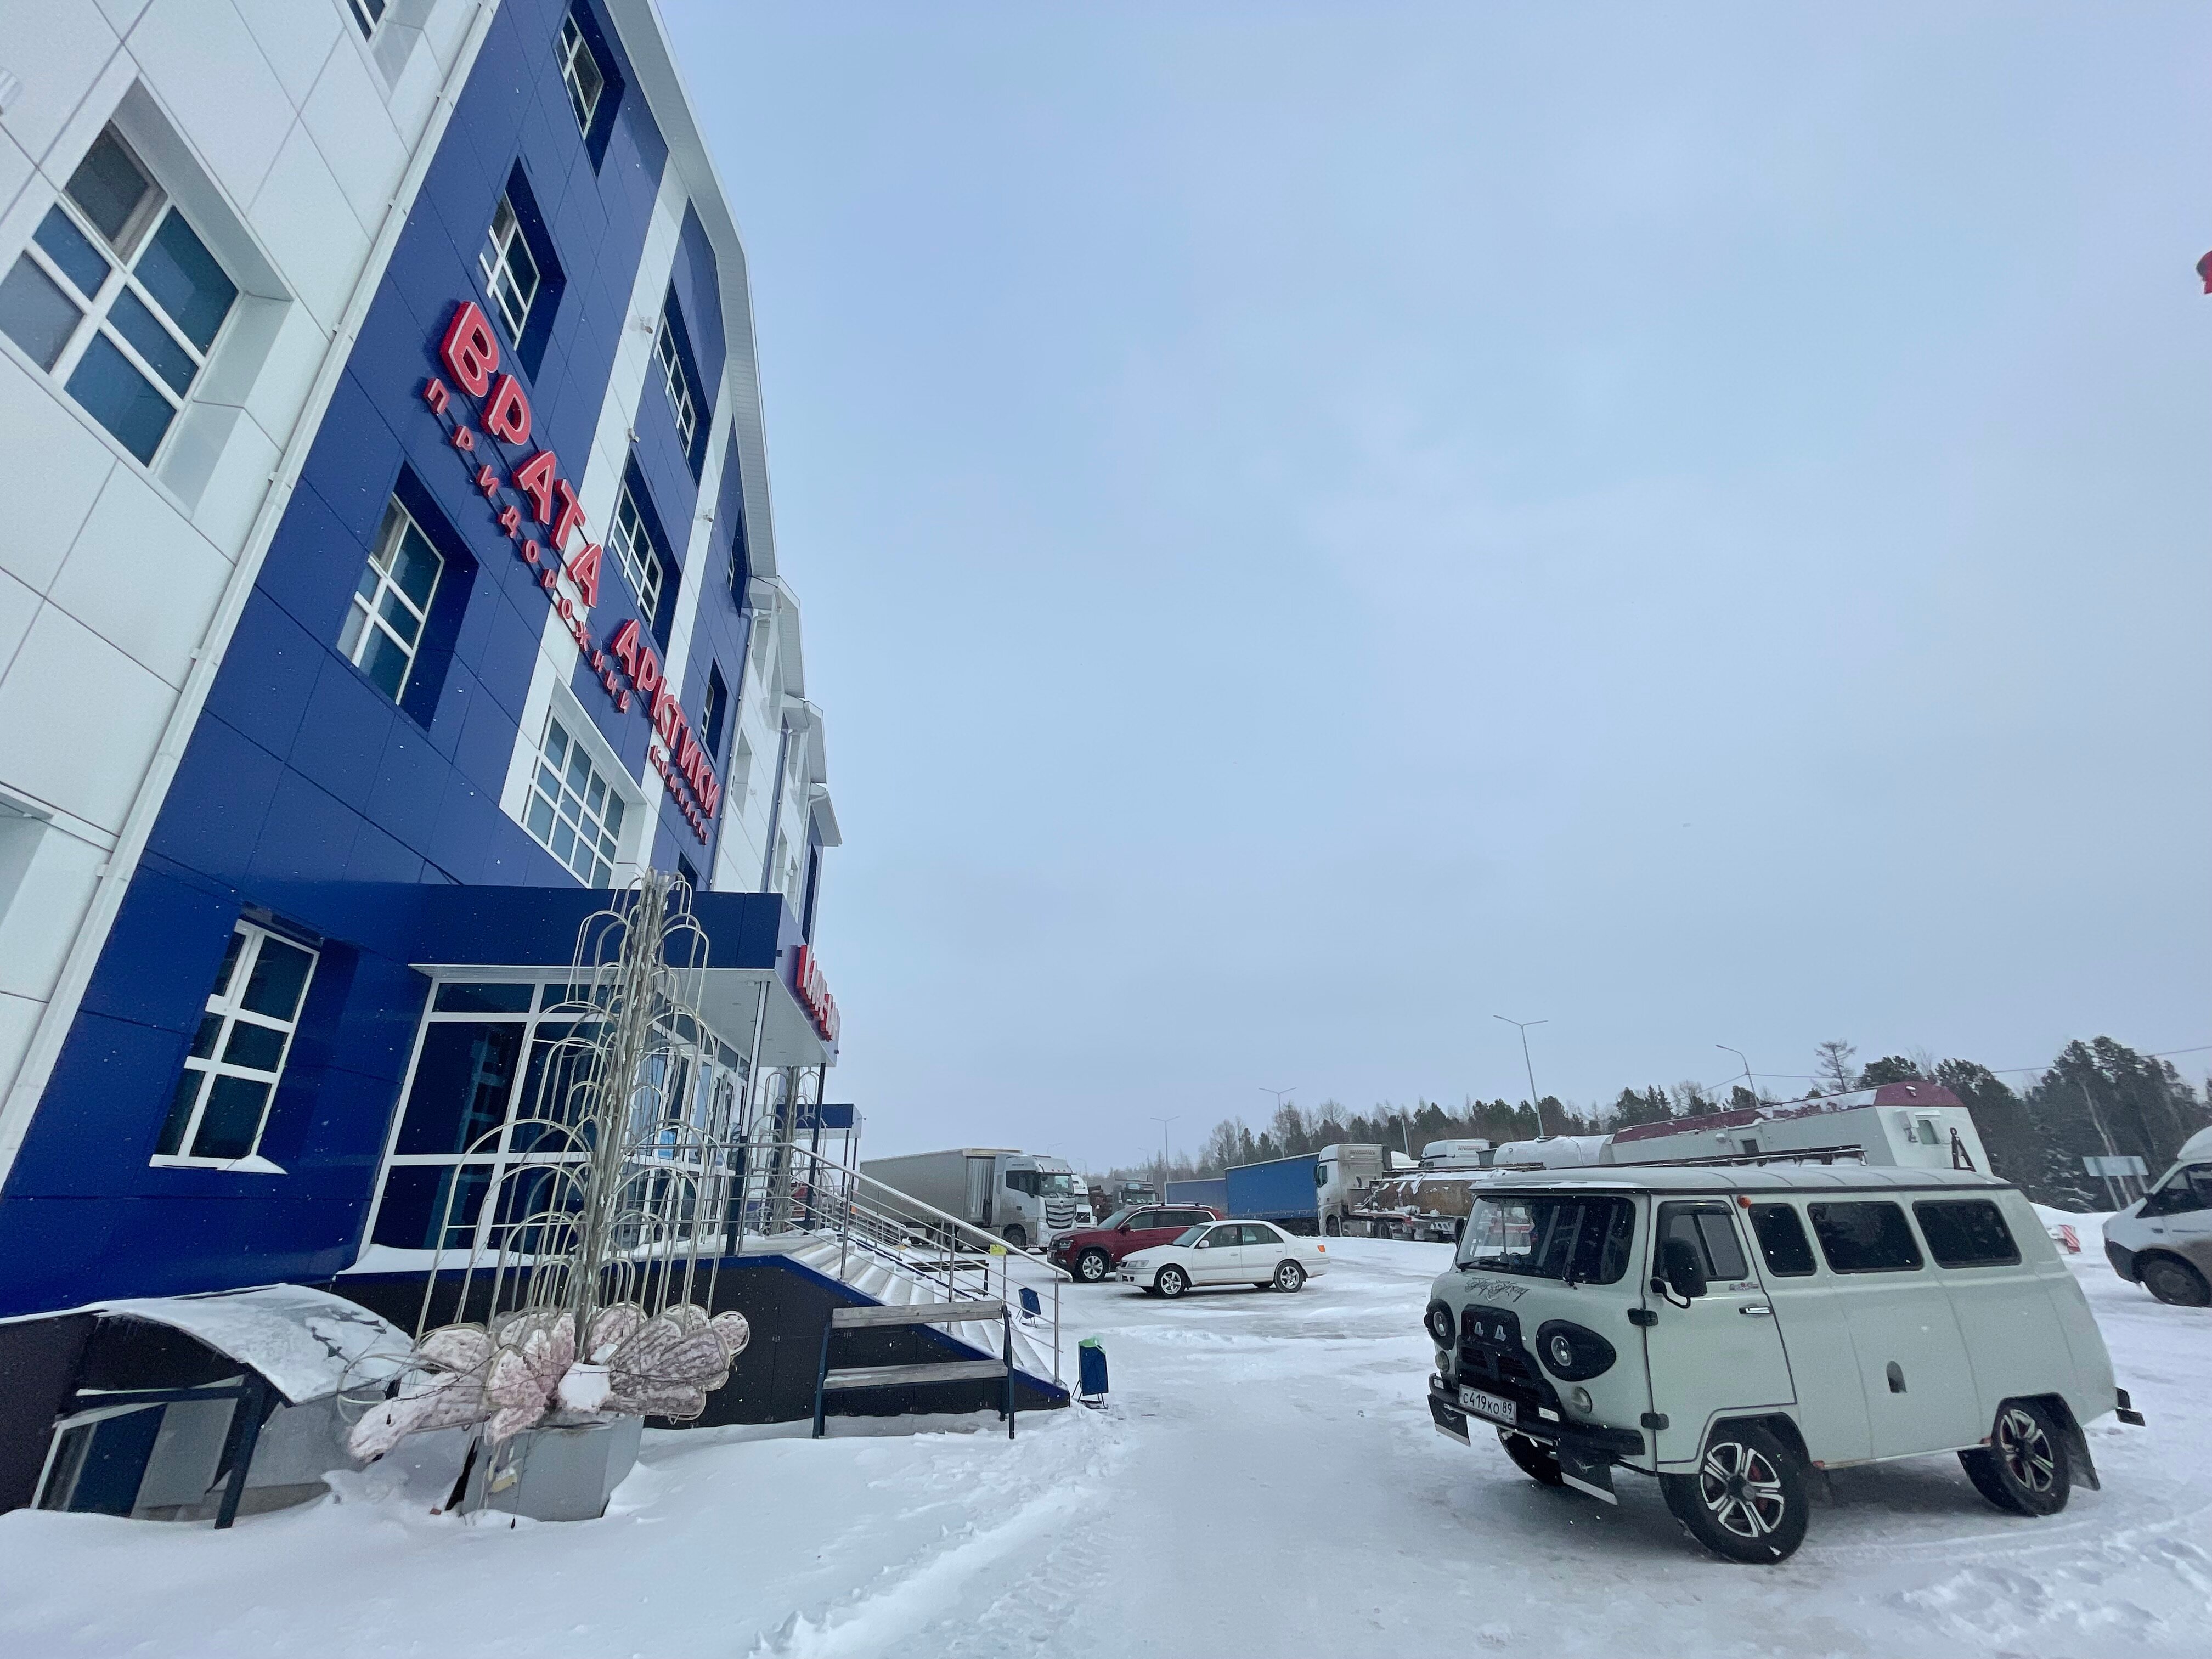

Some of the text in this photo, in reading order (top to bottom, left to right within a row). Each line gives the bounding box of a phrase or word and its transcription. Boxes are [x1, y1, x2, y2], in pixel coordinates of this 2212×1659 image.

[424, 377, 708, 845] ПРИДОРОЖНЫЙ КОМПЛЕКС
[441, 301, 721, 819] ВРАТА АРКТИКИ
[1502, 1402, 1512, 1415] 89
